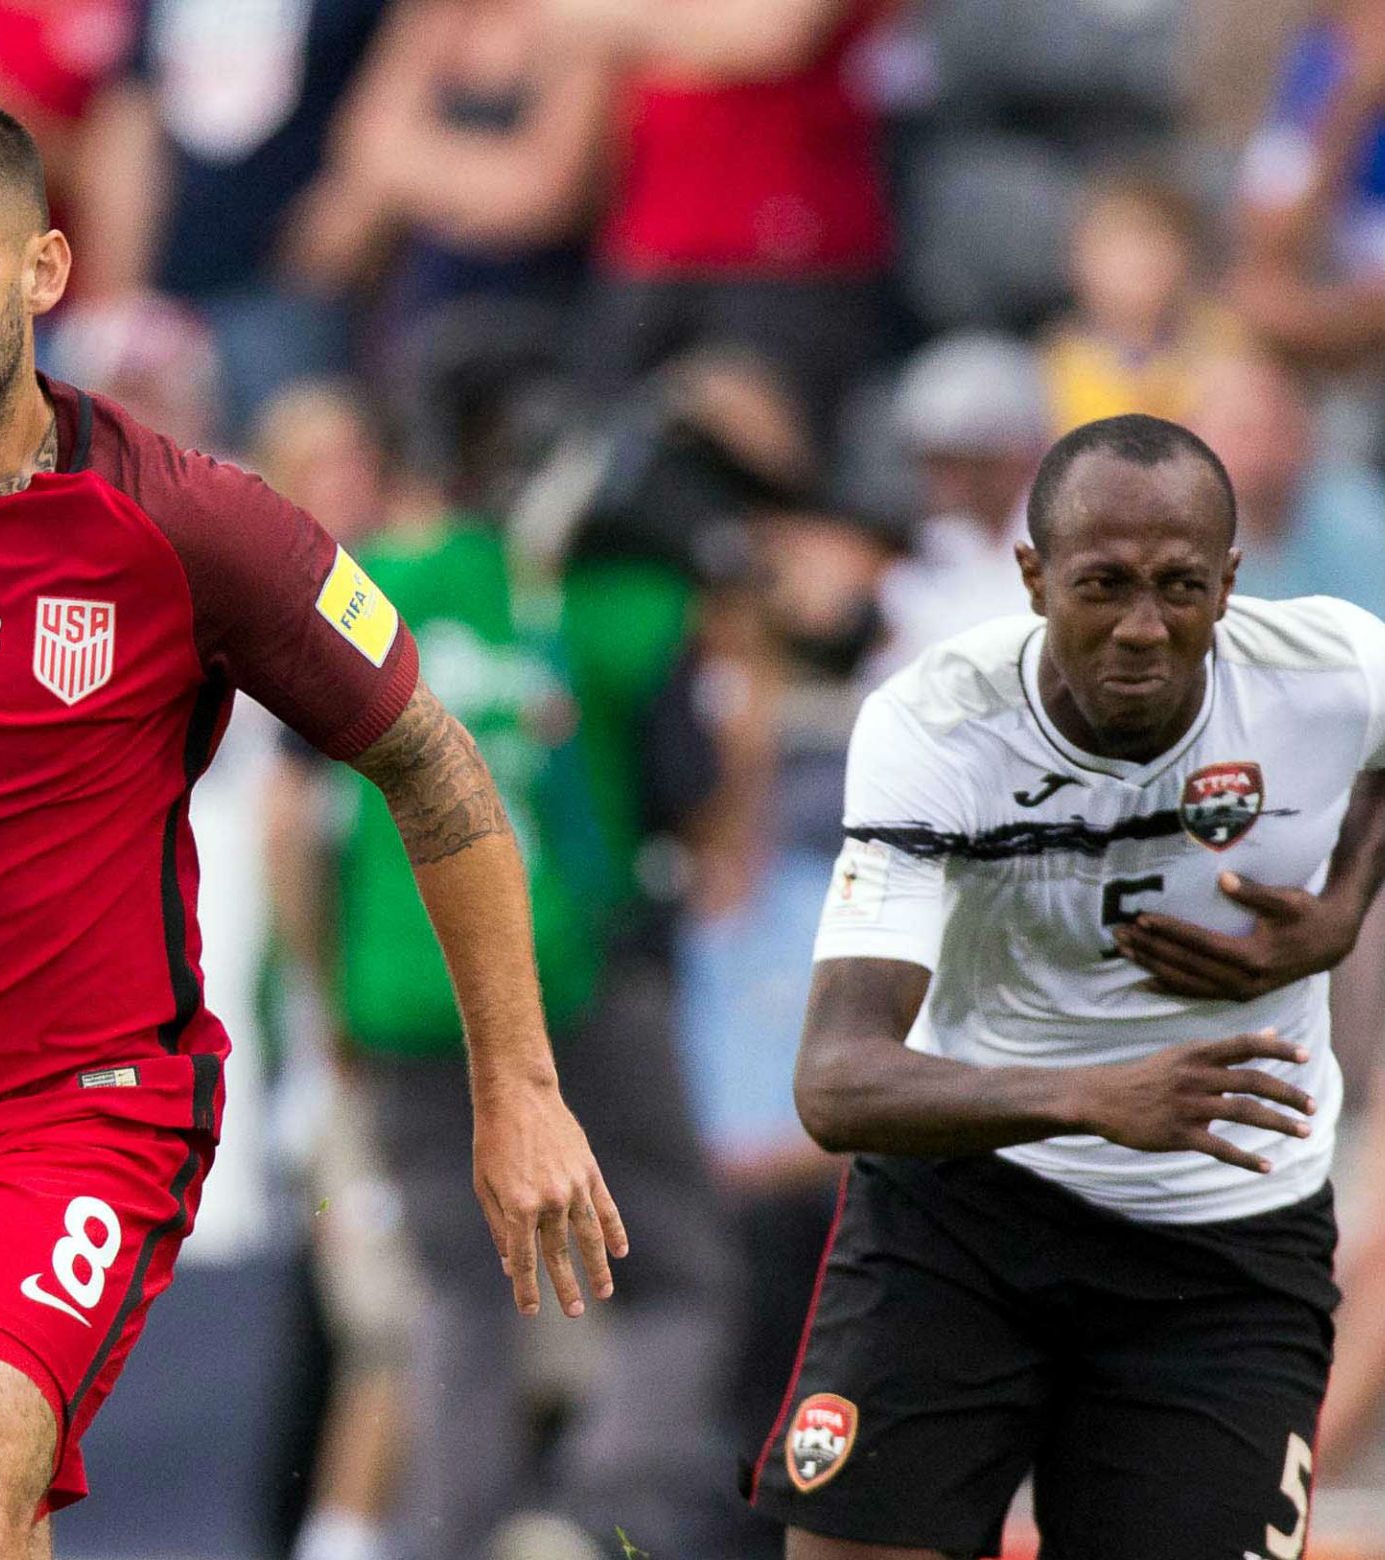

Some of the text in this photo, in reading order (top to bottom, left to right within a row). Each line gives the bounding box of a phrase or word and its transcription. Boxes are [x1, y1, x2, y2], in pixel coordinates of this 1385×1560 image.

[42, 603, 109, 644] USA
[340, 591, 366, 630] FIFA
[52, 1196, 122, 1309] 8
[1265, 1431, 1313, 1560] 5
